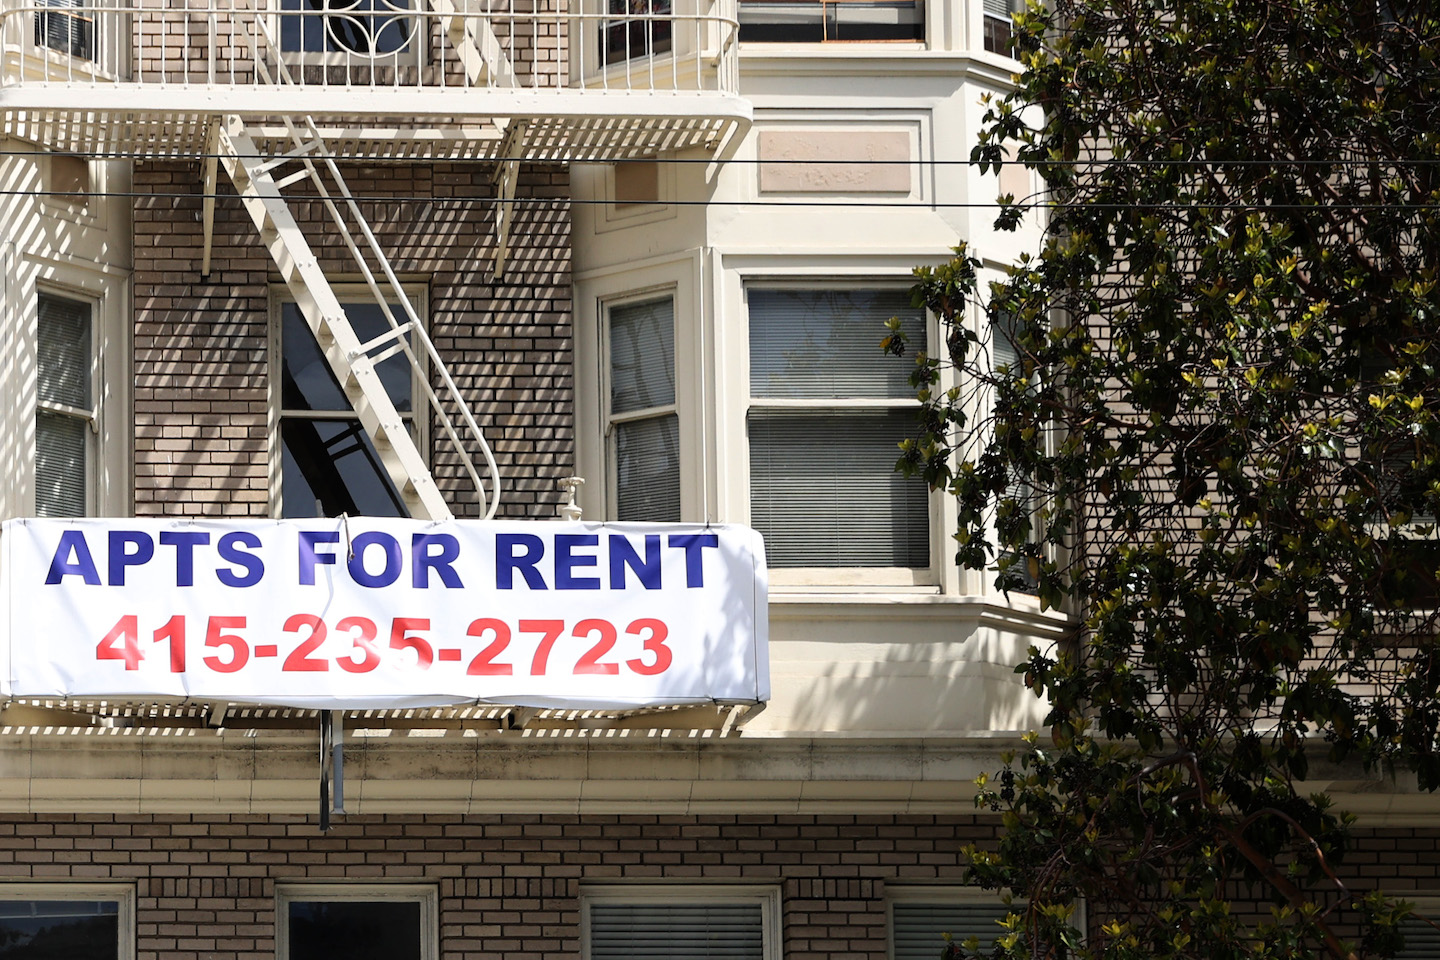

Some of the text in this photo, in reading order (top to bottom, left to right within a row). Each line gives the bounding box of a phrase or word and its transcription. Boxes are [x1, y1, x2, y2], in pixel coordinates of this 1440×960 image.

[45, 530, 719, 591] APTS FOR RENT
[96, 612, 673, 677] 415-235-2723
